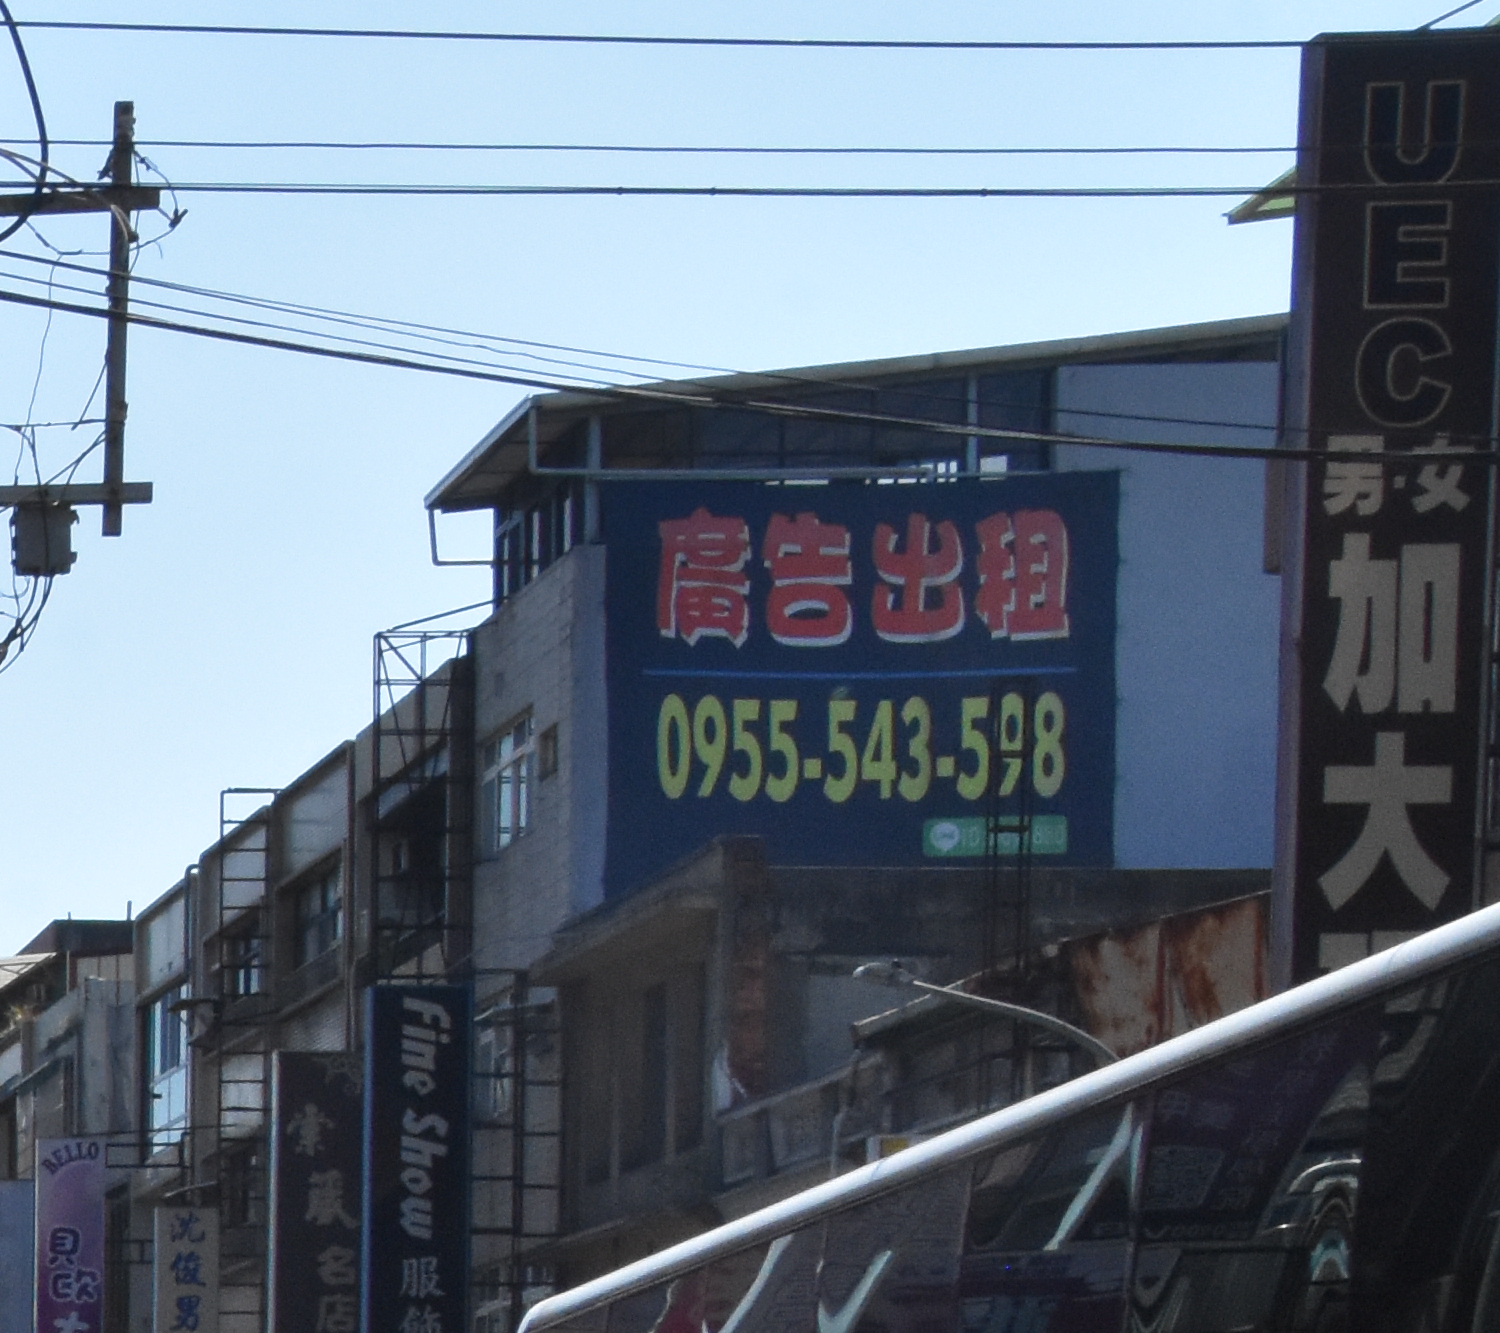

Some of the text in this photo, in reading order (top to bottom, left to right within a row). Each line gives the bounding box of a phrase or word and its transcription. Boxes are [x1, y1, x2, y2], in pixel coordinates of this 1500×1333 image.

[1355, 79, 1467, 428] UEC
[656, 505, 1071, 649] 廣告出租
[1317, 532, 1462, 970] 加大
[41, 1140, 100, 1176] BELLO
[400, 1108, 450, 1241] Show
